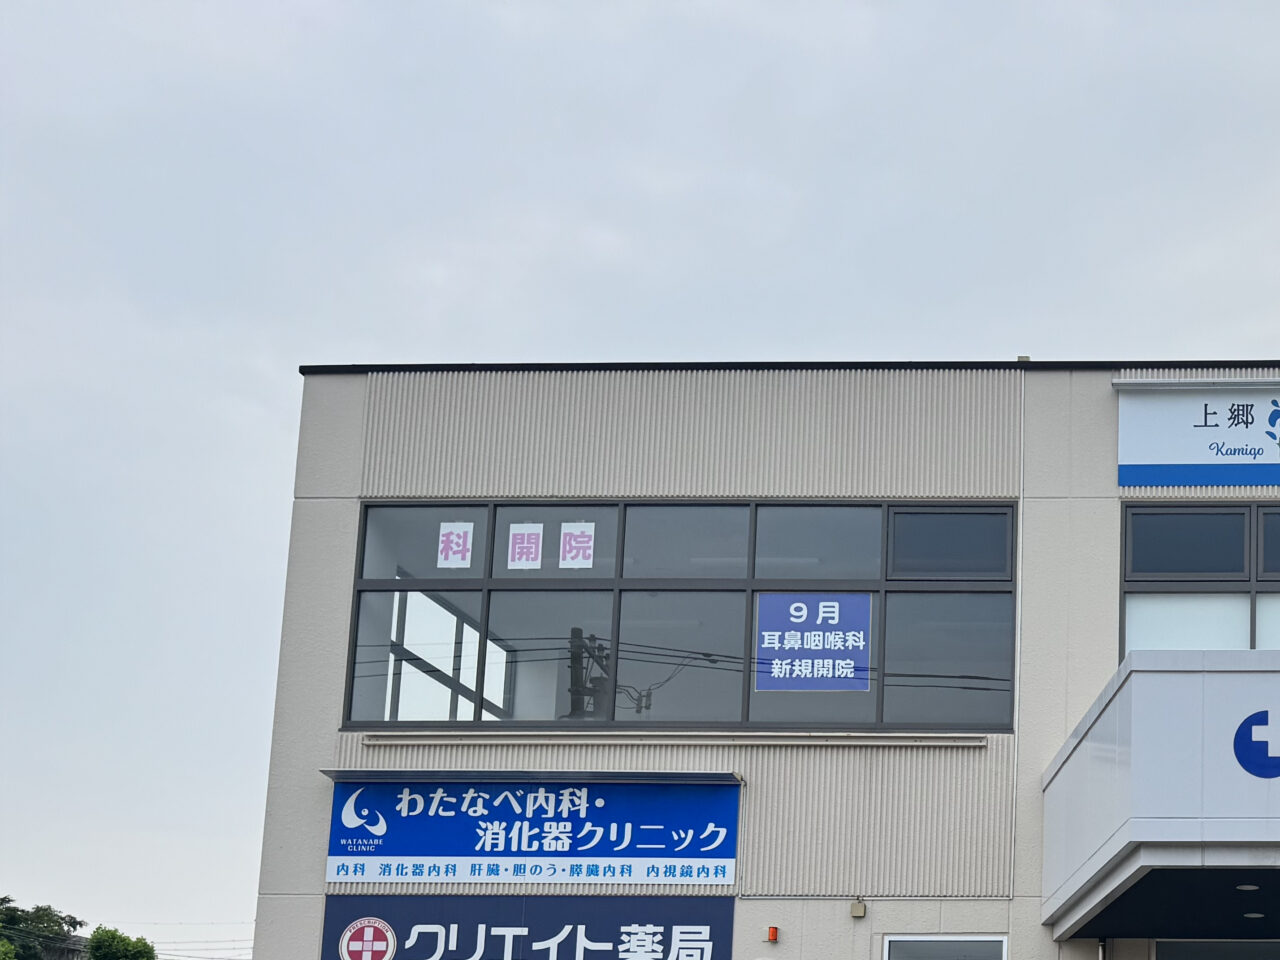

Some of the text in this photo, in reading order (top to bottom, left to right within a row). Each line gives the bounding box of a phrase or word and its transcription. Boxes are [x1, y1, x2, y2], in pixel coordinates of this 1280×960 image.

[1192, 402, 1255, 429] 上郷
[1208, 441, 1264, 460] Kamigo
[440, 530, 470, 561] 科
[789, 601, 840, 625] 9月
[761, 630, 866, 650] 耳鼻咽喉科
[771, 658, 855, 678] 新規開院
[474, 820, 727, 852] 消化器クリニック
[336, 863, 366, 876] 内科
[378, 863, 457, 876] 消化器内科
[646, 864, 727, 878] 内視鏡内科
